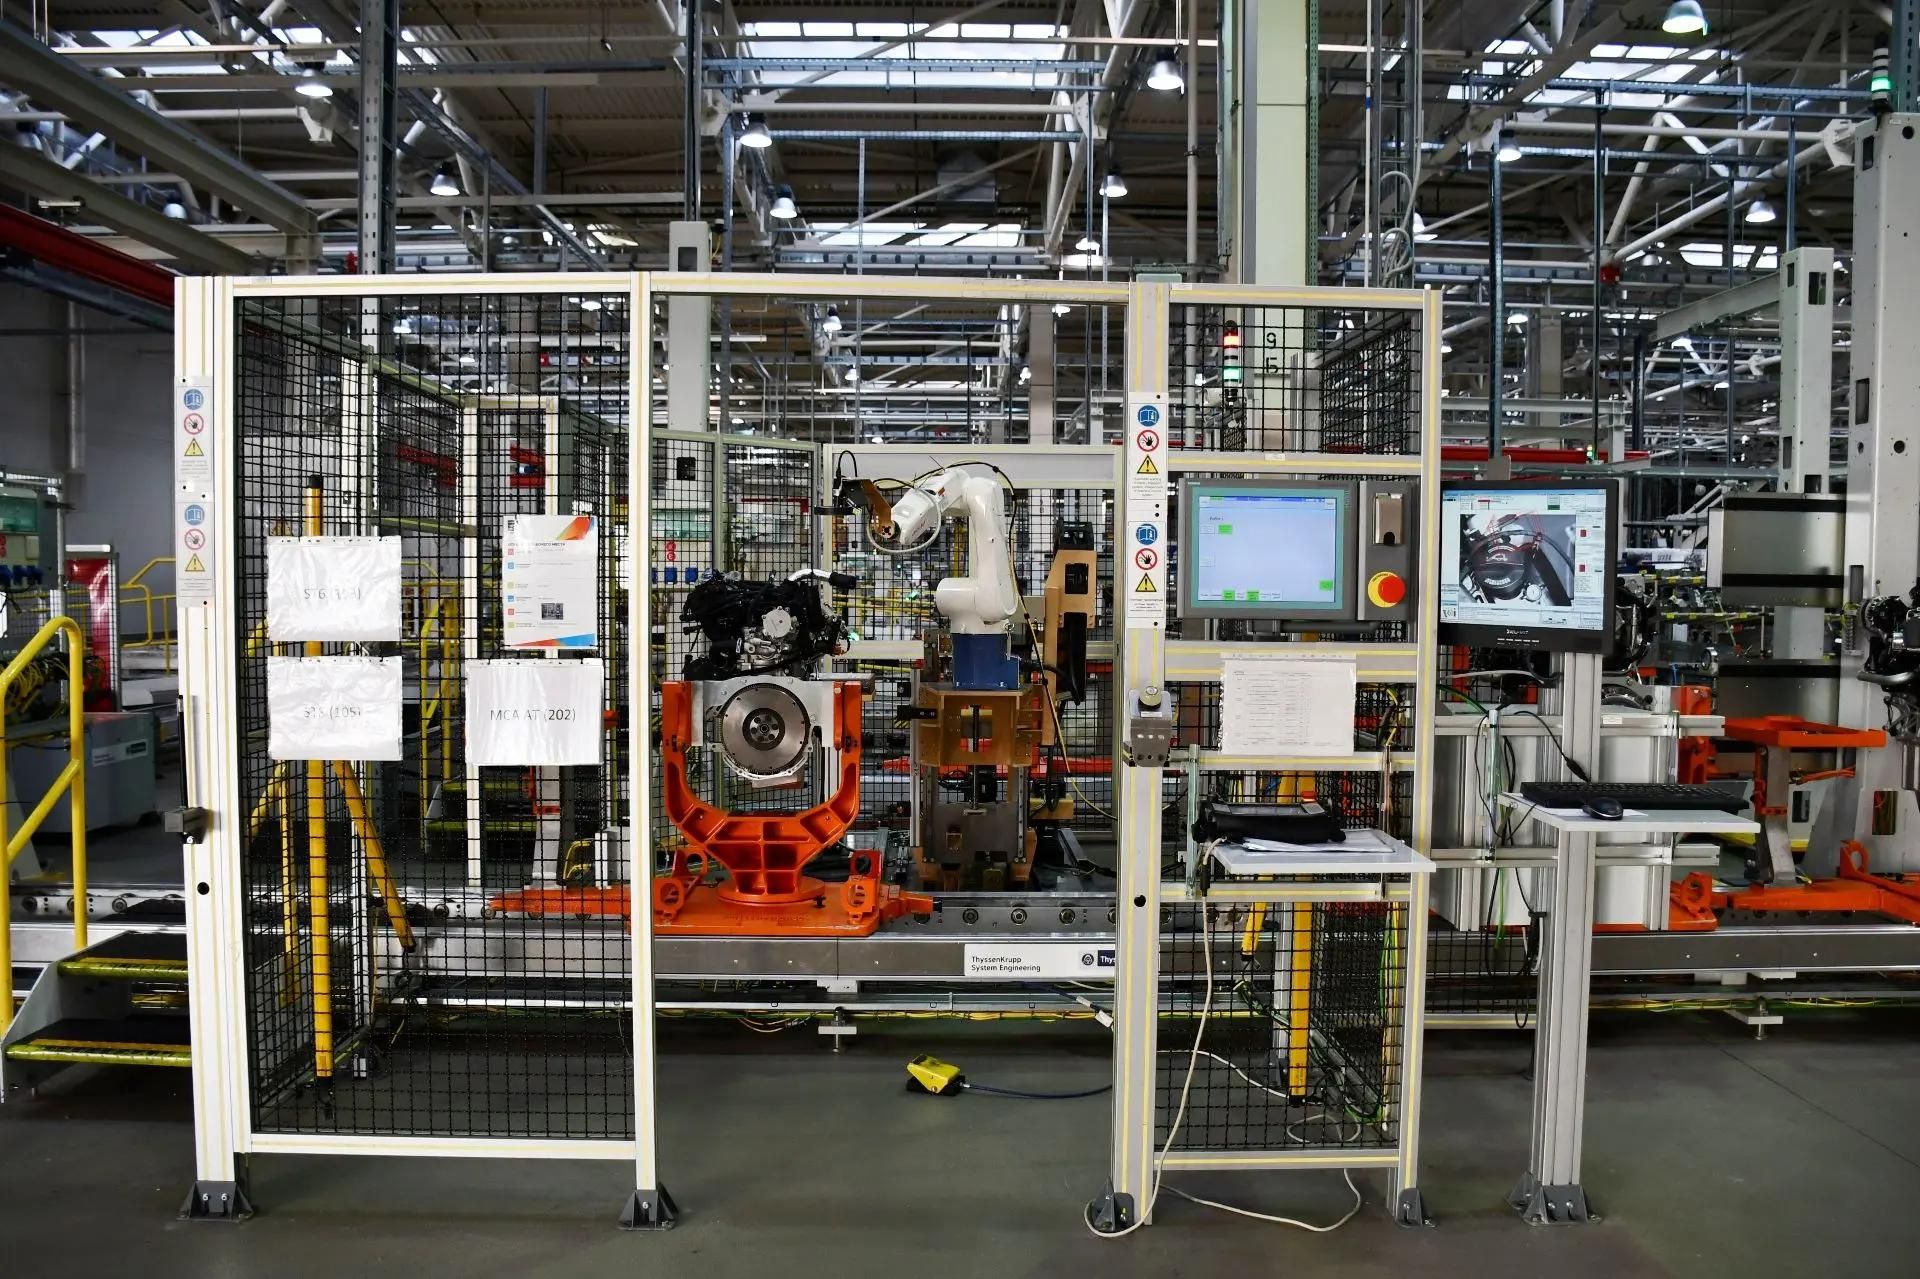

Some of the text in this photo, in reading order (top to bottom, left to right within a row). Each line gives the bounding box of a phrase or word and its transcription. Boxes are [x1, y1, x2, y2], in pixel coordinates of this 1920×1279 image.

[1266, 332, 1277, 349] 9
[490, 709, 520, 721] MCA
[543, 708, 576, 723] (202)
[972, 955, 1022, 964] ThyssenKrupp
[971, 964, 1041, 973] System Engineering
